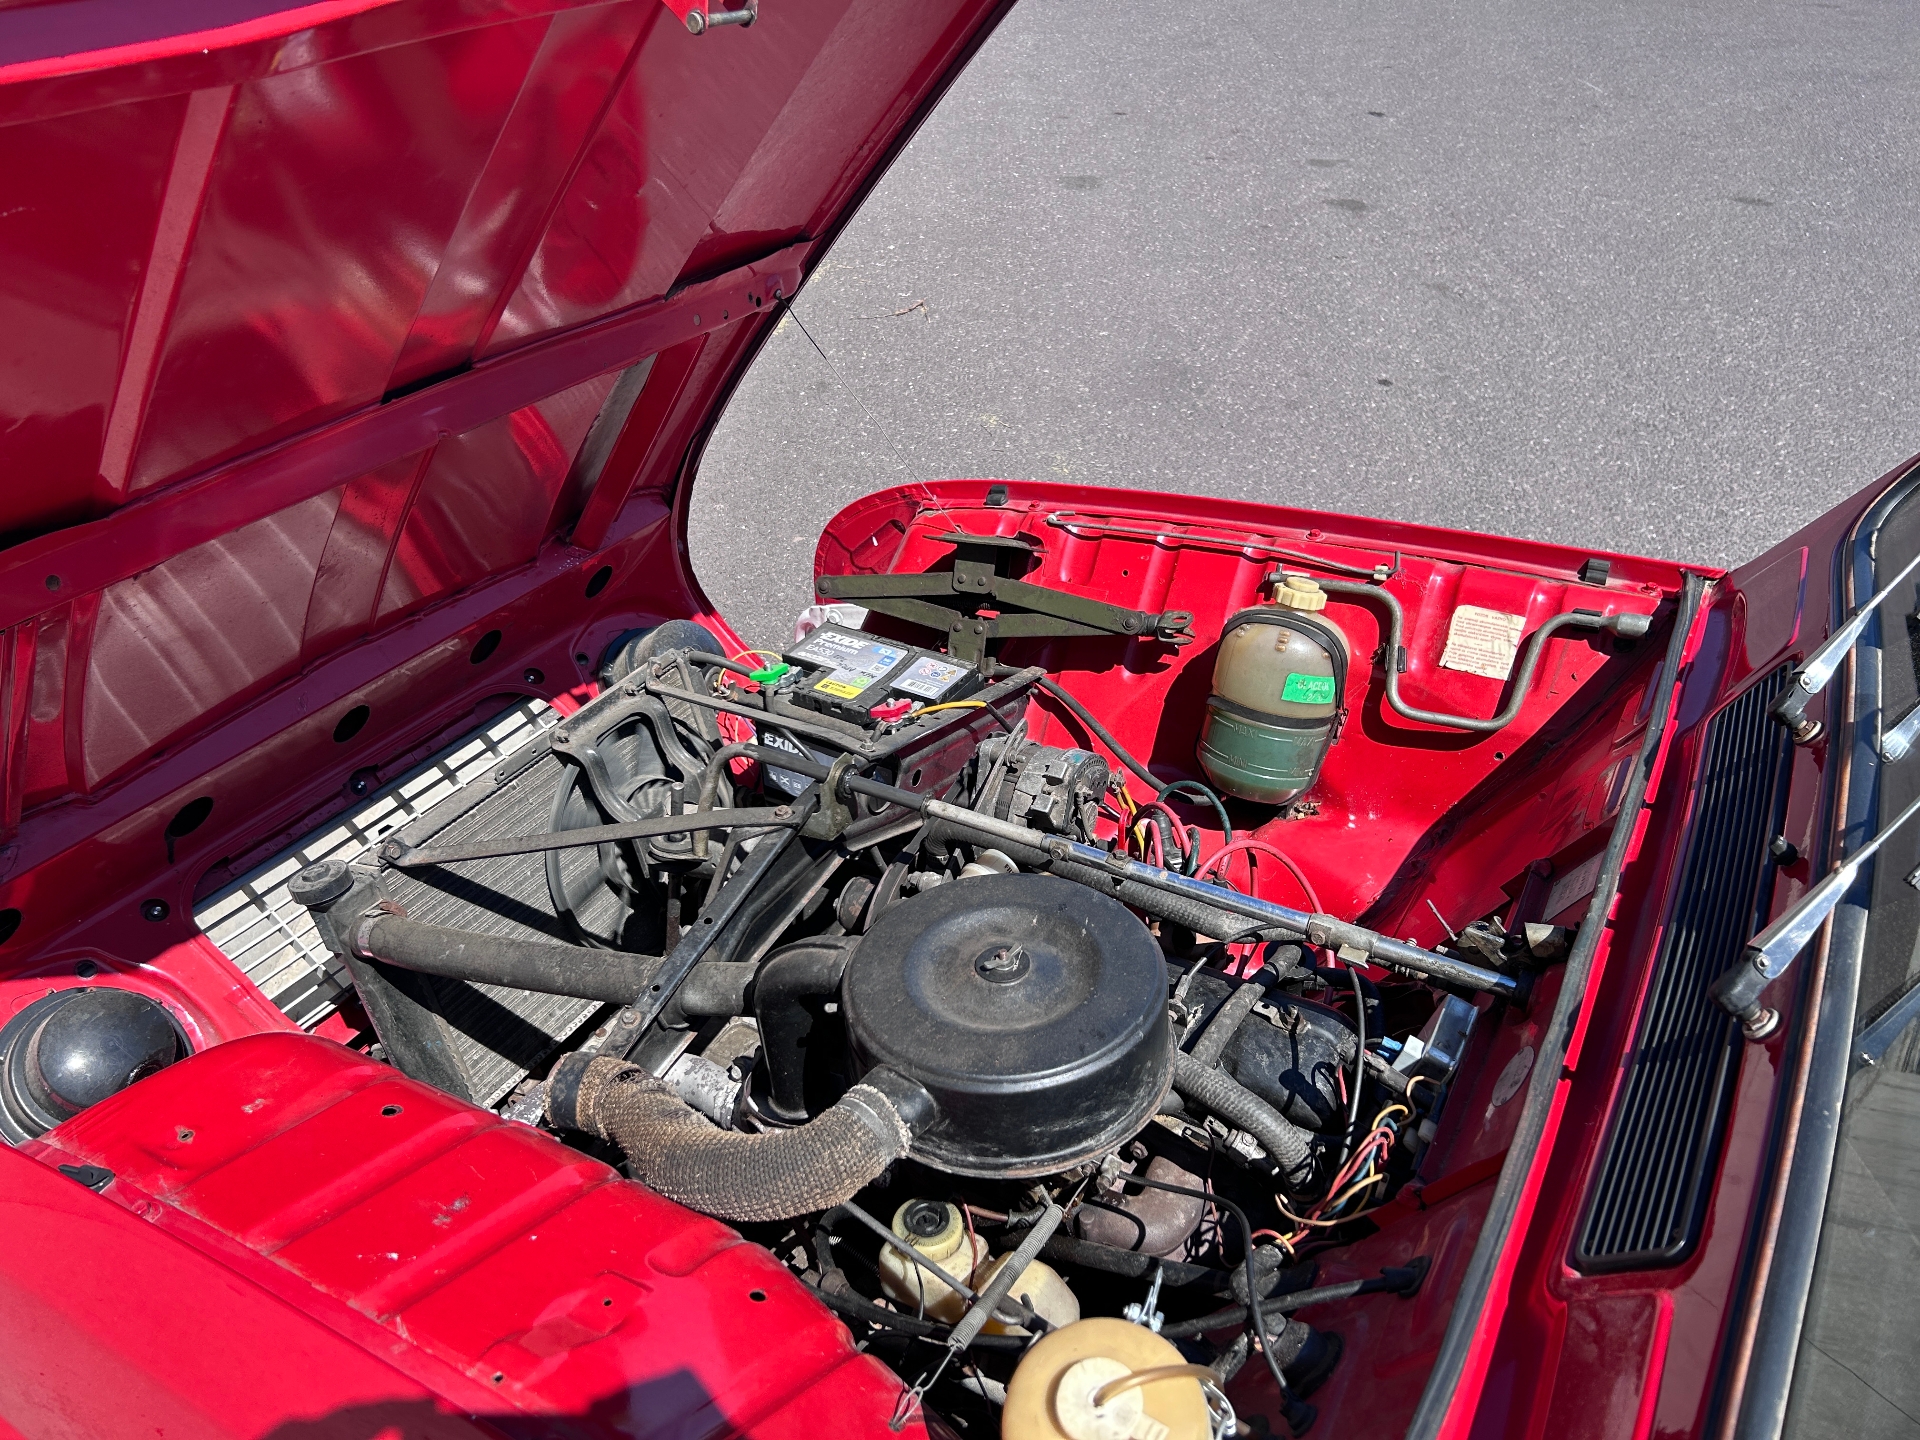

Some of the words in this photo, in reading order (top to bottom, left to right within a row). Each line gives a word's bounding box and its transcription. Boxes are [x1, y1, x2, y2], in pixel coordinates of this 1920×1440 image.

[813, 639, 859, 655] Premium
[820, 631, 869, 649] EXIDE
[764, 732, 804, 757] EXID
